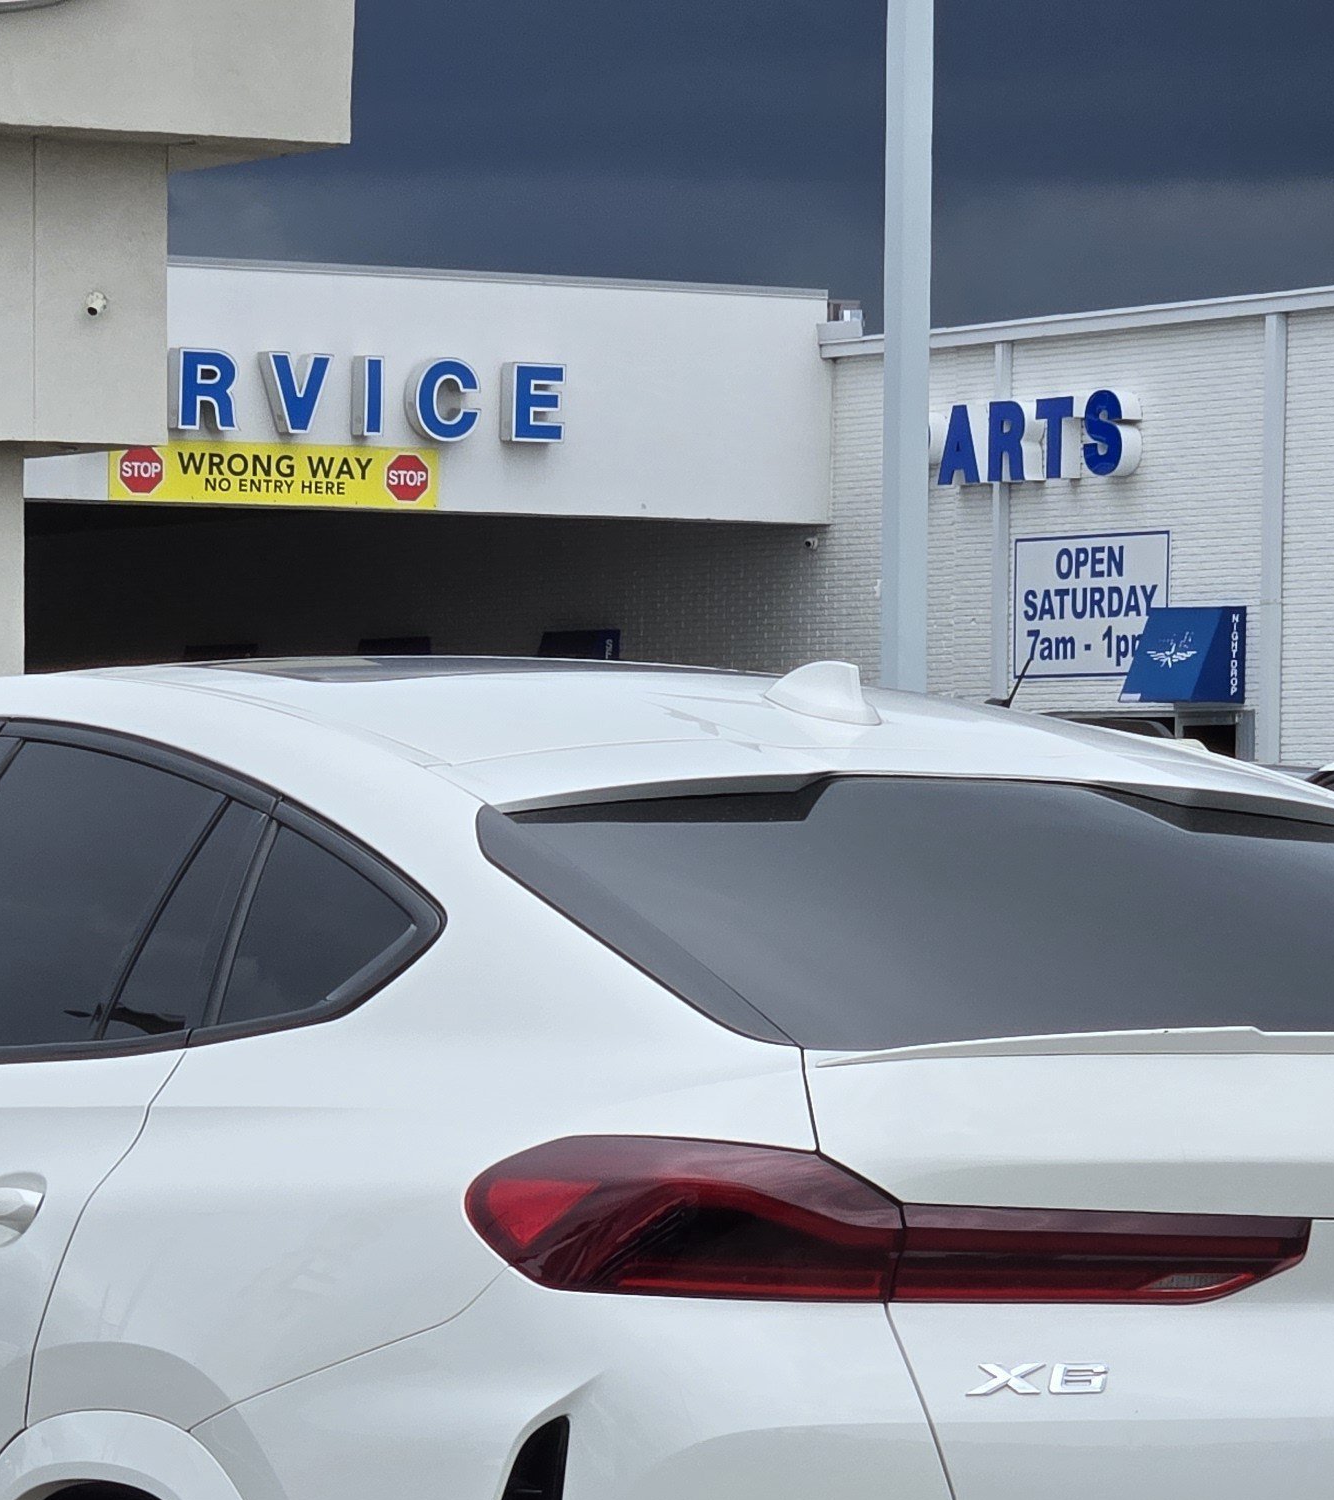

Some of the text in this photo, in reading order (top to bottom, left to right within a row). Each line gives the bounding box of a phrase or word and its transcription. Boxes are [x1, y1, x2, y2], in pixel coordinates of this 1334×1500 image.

[171, 346, 566, 442] RVICE
[929, 389, 1125, 486] ARTS
[121, 462, 162, 478] STOP
[177, 451, 373, 480] WRONG WAY
[387, 469, 427, 486] STOP
[204, 477, 346, 495] NO ENTRY HERE
[1055, 545, 1124, 580] OPEN
[1023, 584, 1158, 621] SATURDAY
[1026, 629, 1076, 661] 7am
[1230, 613, 1240, 696] NIGHT DROP
[965, 1362, 1110, 1397] X6
